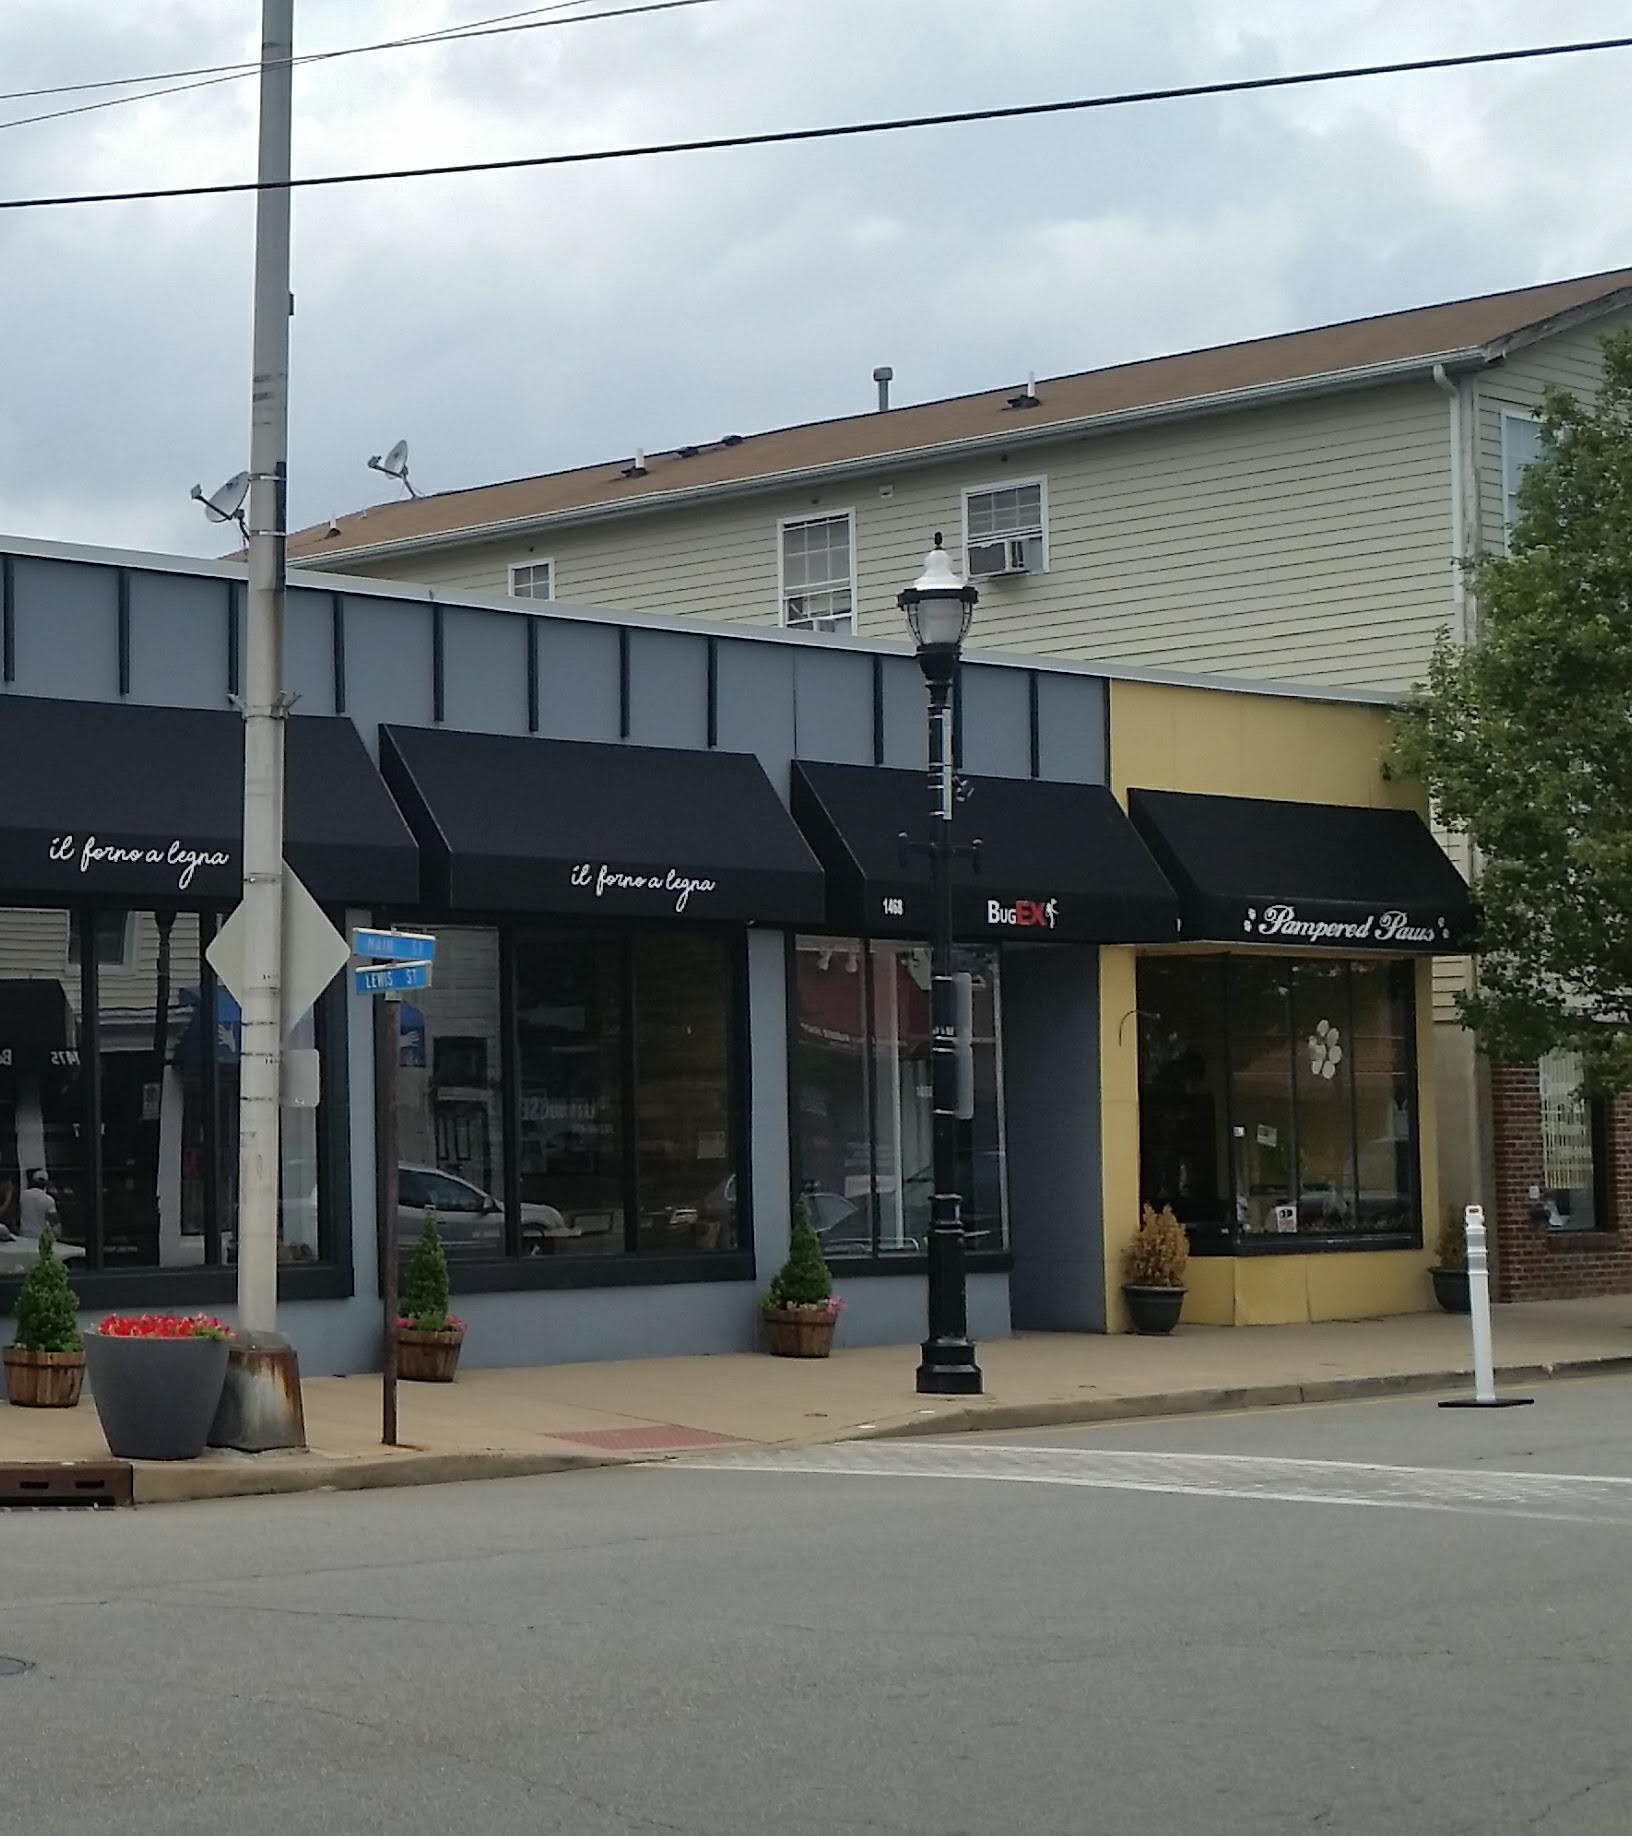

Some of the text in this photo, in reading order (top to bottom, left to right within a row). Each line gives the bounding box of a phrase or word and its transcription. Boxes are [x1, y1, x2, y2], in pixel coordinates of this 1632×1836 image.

[49, 835, 229, 890] il forno a legna
[571, 864, 716, 913] il forno a legna
[1257, 904, 1435, 943] Pampered Paws
[365, 968, 417, 989] LEWIS ST
